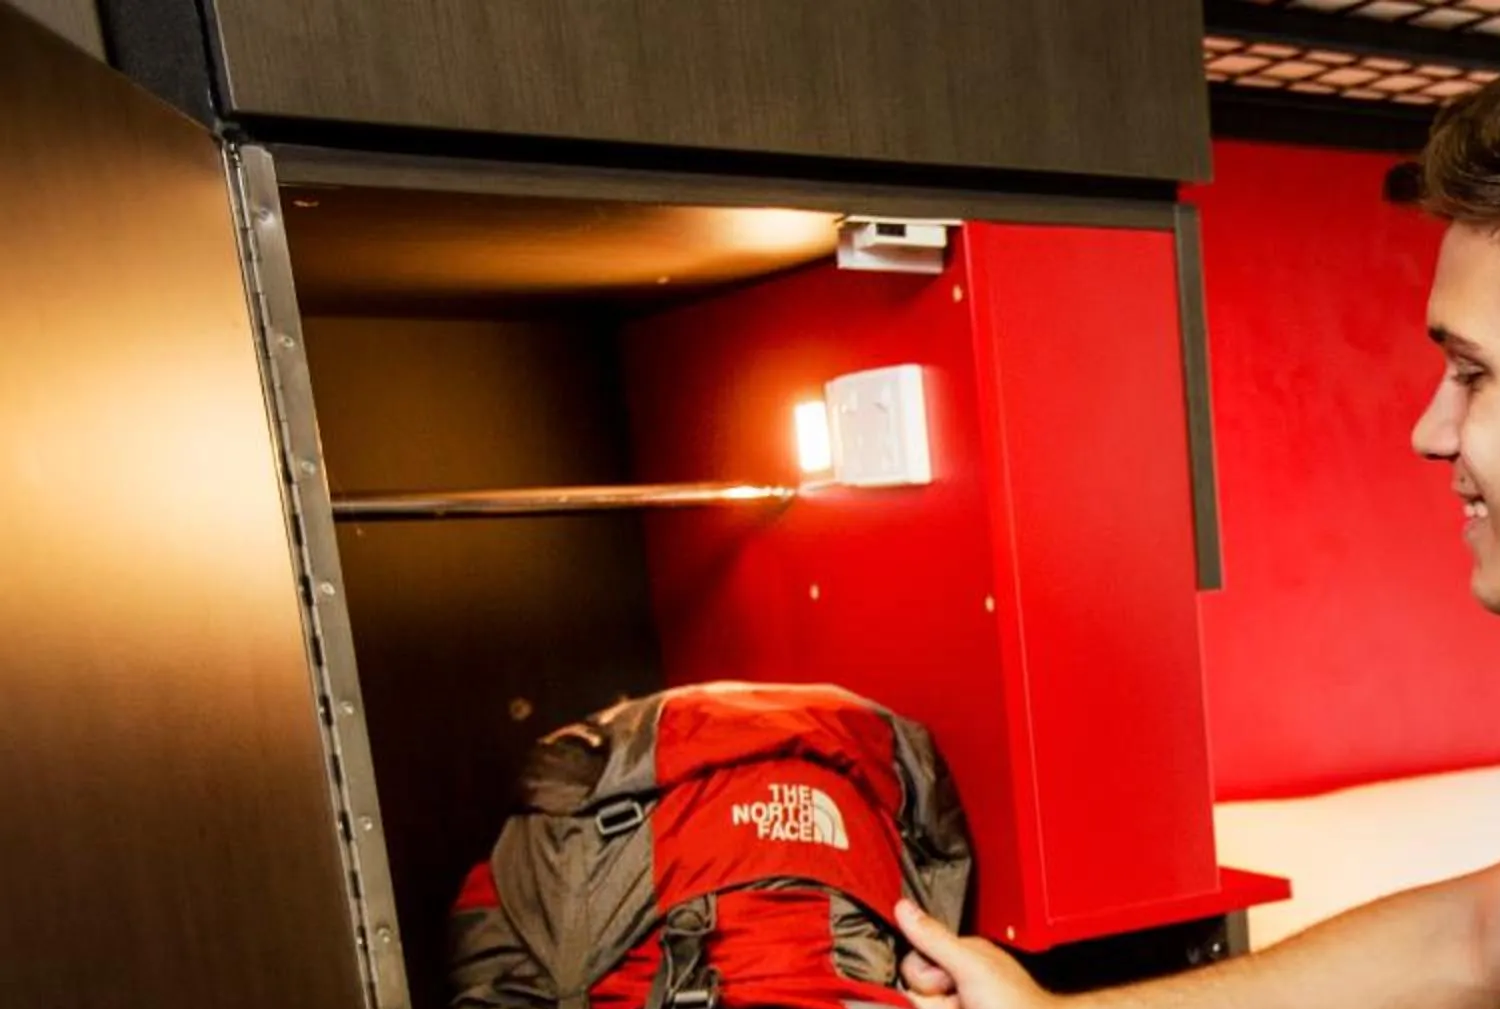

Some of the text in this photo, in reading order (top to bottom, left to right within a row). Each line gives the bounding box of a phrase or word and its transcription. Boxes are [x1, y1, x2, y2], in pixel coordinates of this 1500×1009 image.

[768, 783, 810, 803] THE
[732, 801, 813, 826] NORTH
[758, 820, 814, 842] FACE
